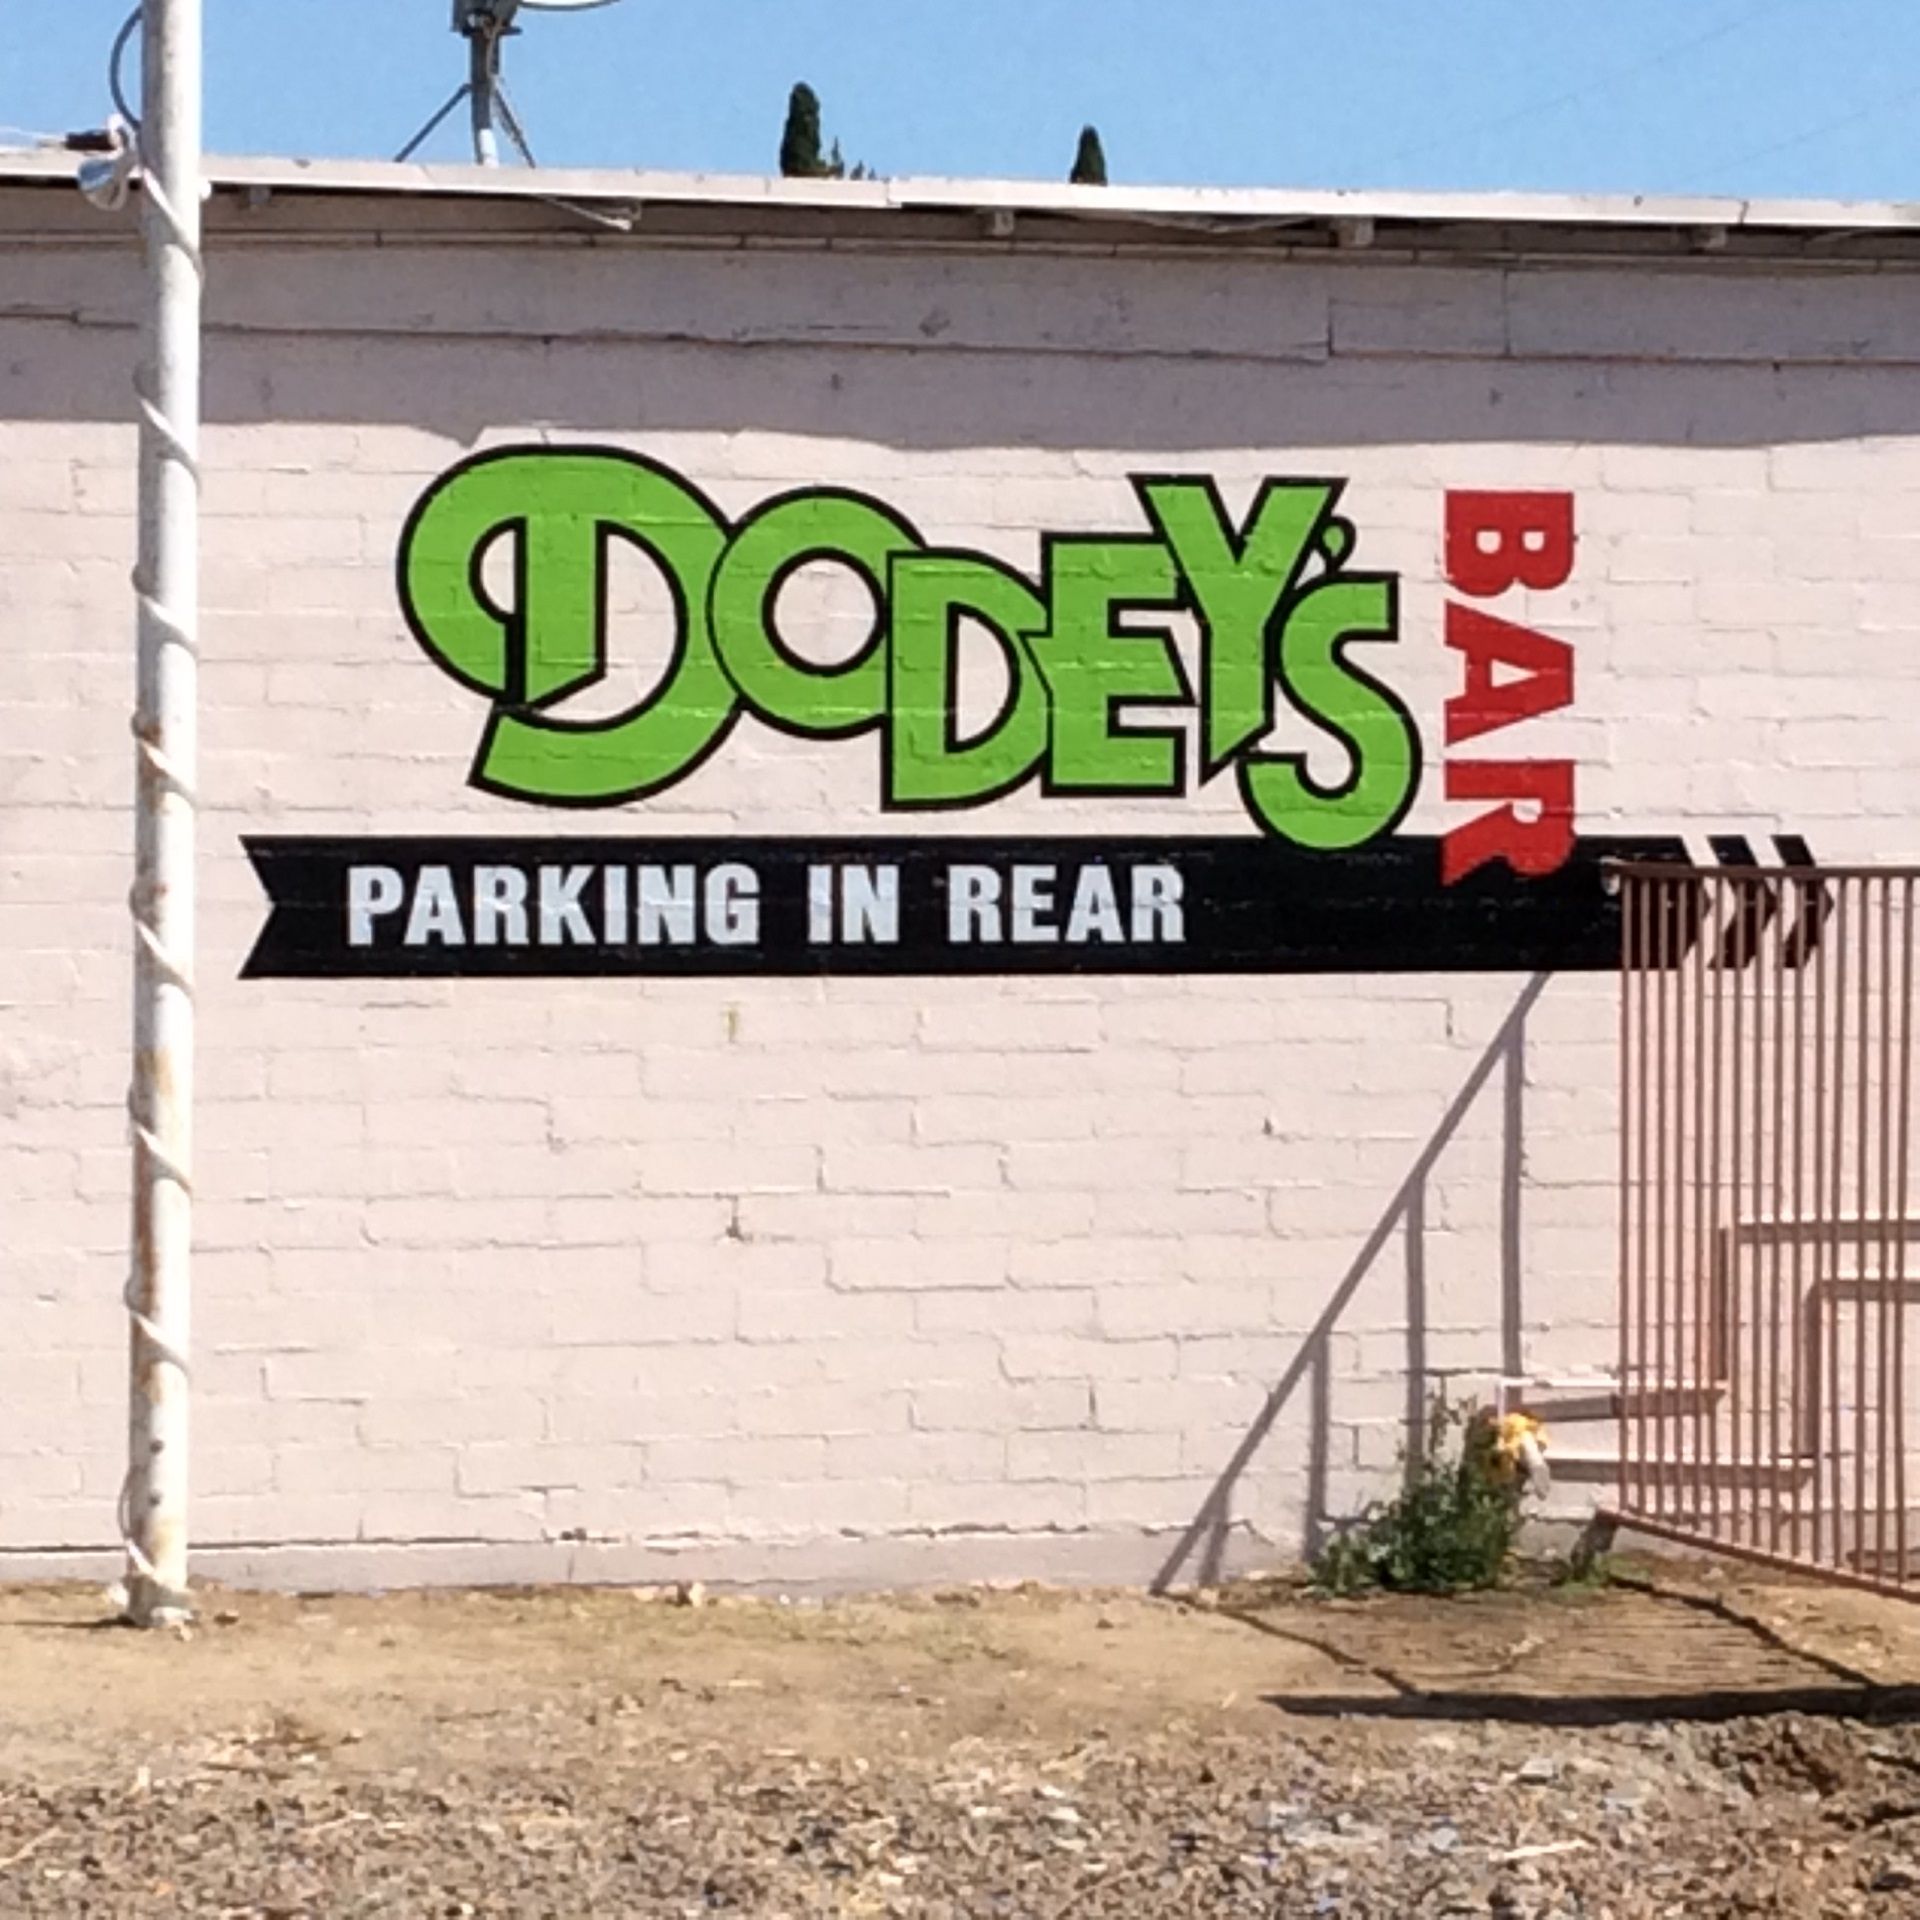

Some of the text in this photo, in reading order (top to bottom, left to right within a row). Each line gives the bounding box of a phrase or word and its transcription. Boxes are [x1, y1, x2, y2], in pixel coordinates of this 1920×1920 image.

[1444, 489, 1576, 882] BAR
[348, 864, 1185, 945] PARKING IN REAR
